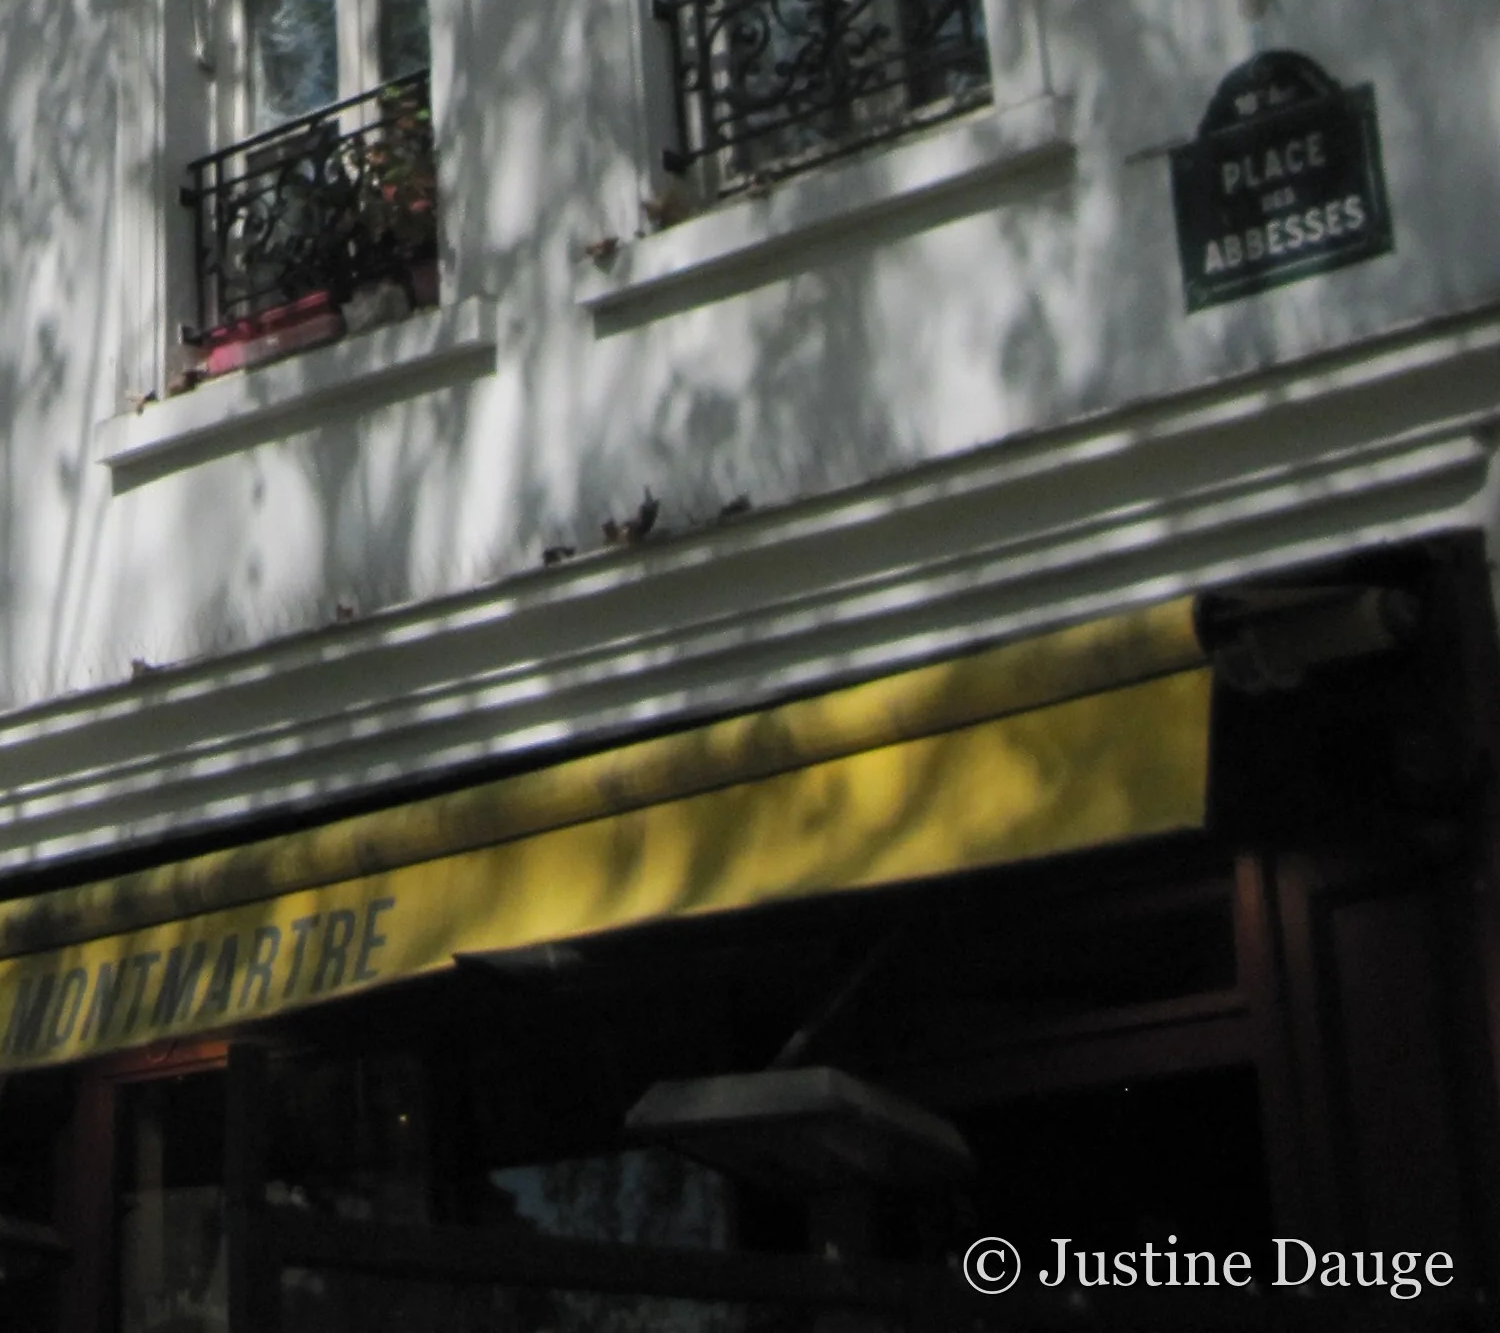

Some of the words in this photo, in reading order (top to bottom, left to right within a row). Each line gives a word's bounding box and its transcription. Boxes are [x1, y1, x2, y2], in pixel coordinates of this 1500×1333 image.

[1222, 132, 1327, 195] PLACE
[1204, 195, 1366, 275] ABBESSES
[4, 897, 397, 1054] MONTMARTRE
